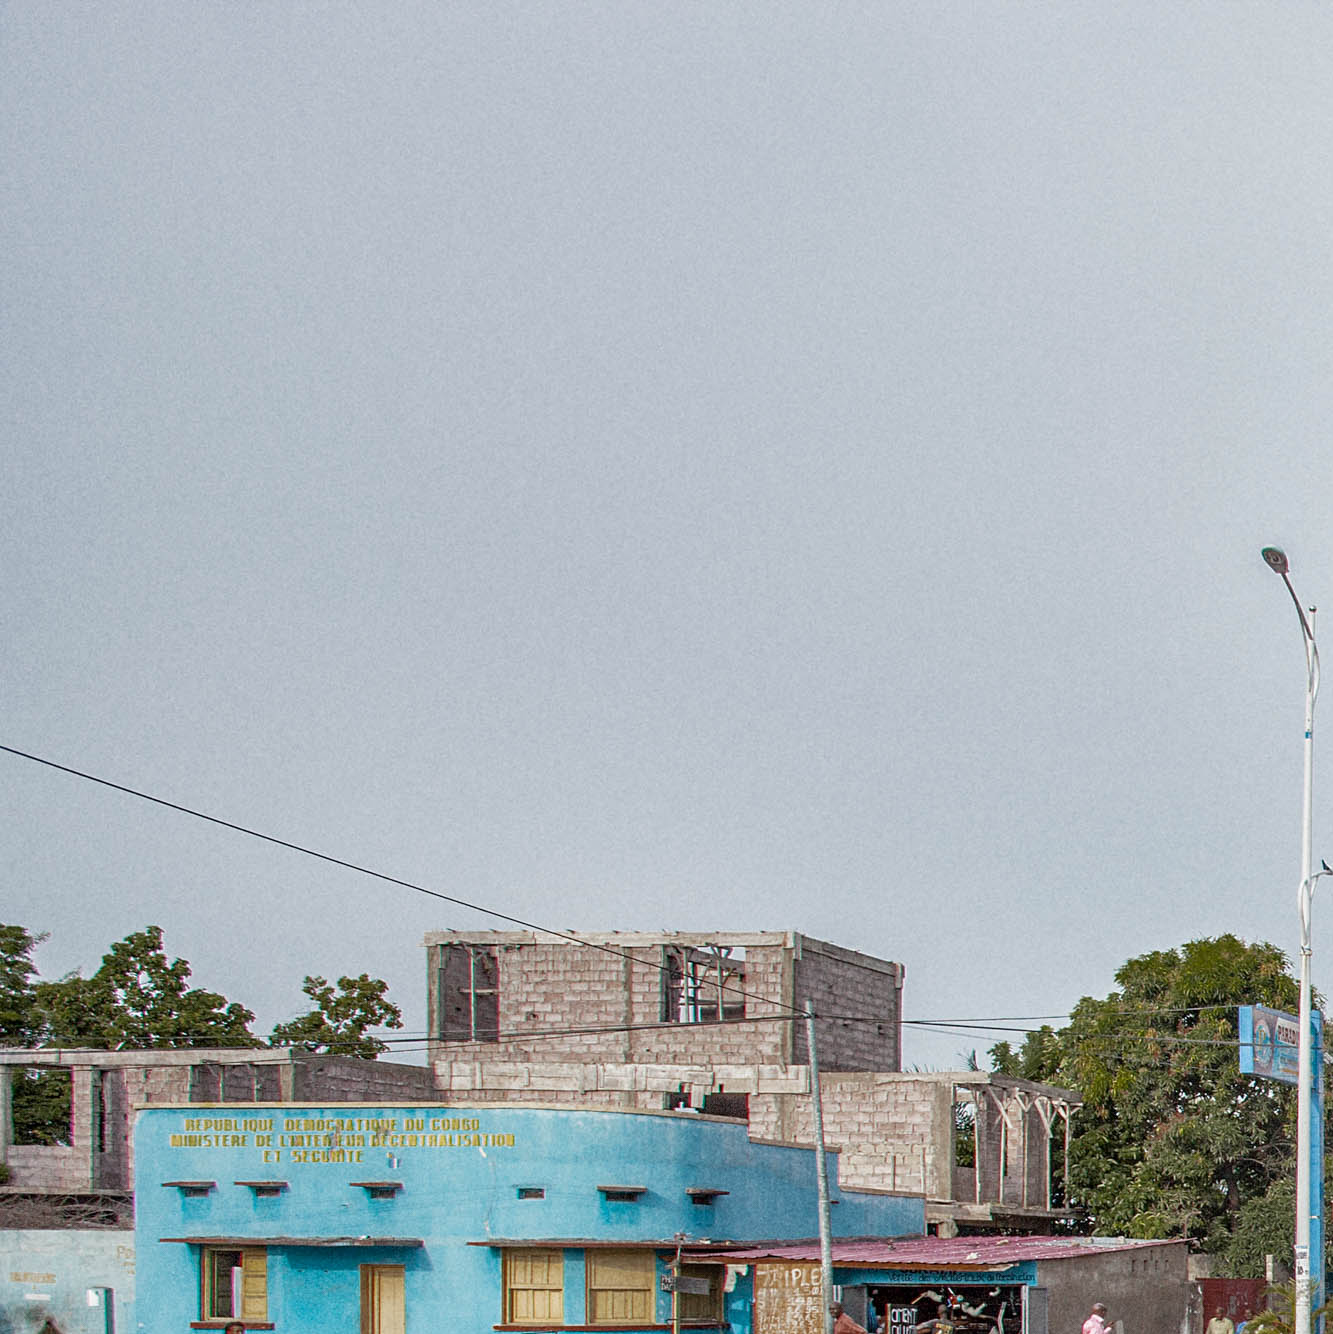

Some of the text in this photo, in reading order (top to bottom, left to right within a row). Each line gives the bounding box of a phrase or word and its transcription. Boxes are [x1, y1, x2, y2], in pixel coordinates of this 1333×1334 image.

[404, 1118, 424, 1131] DU
[430, 1118, 480, 1131] CONGO
[255, 1134, 273, 1147] DE
[279, 1134, 366, 1147] L'INTEREUR
[263, 1150, 281, 1163] ET
